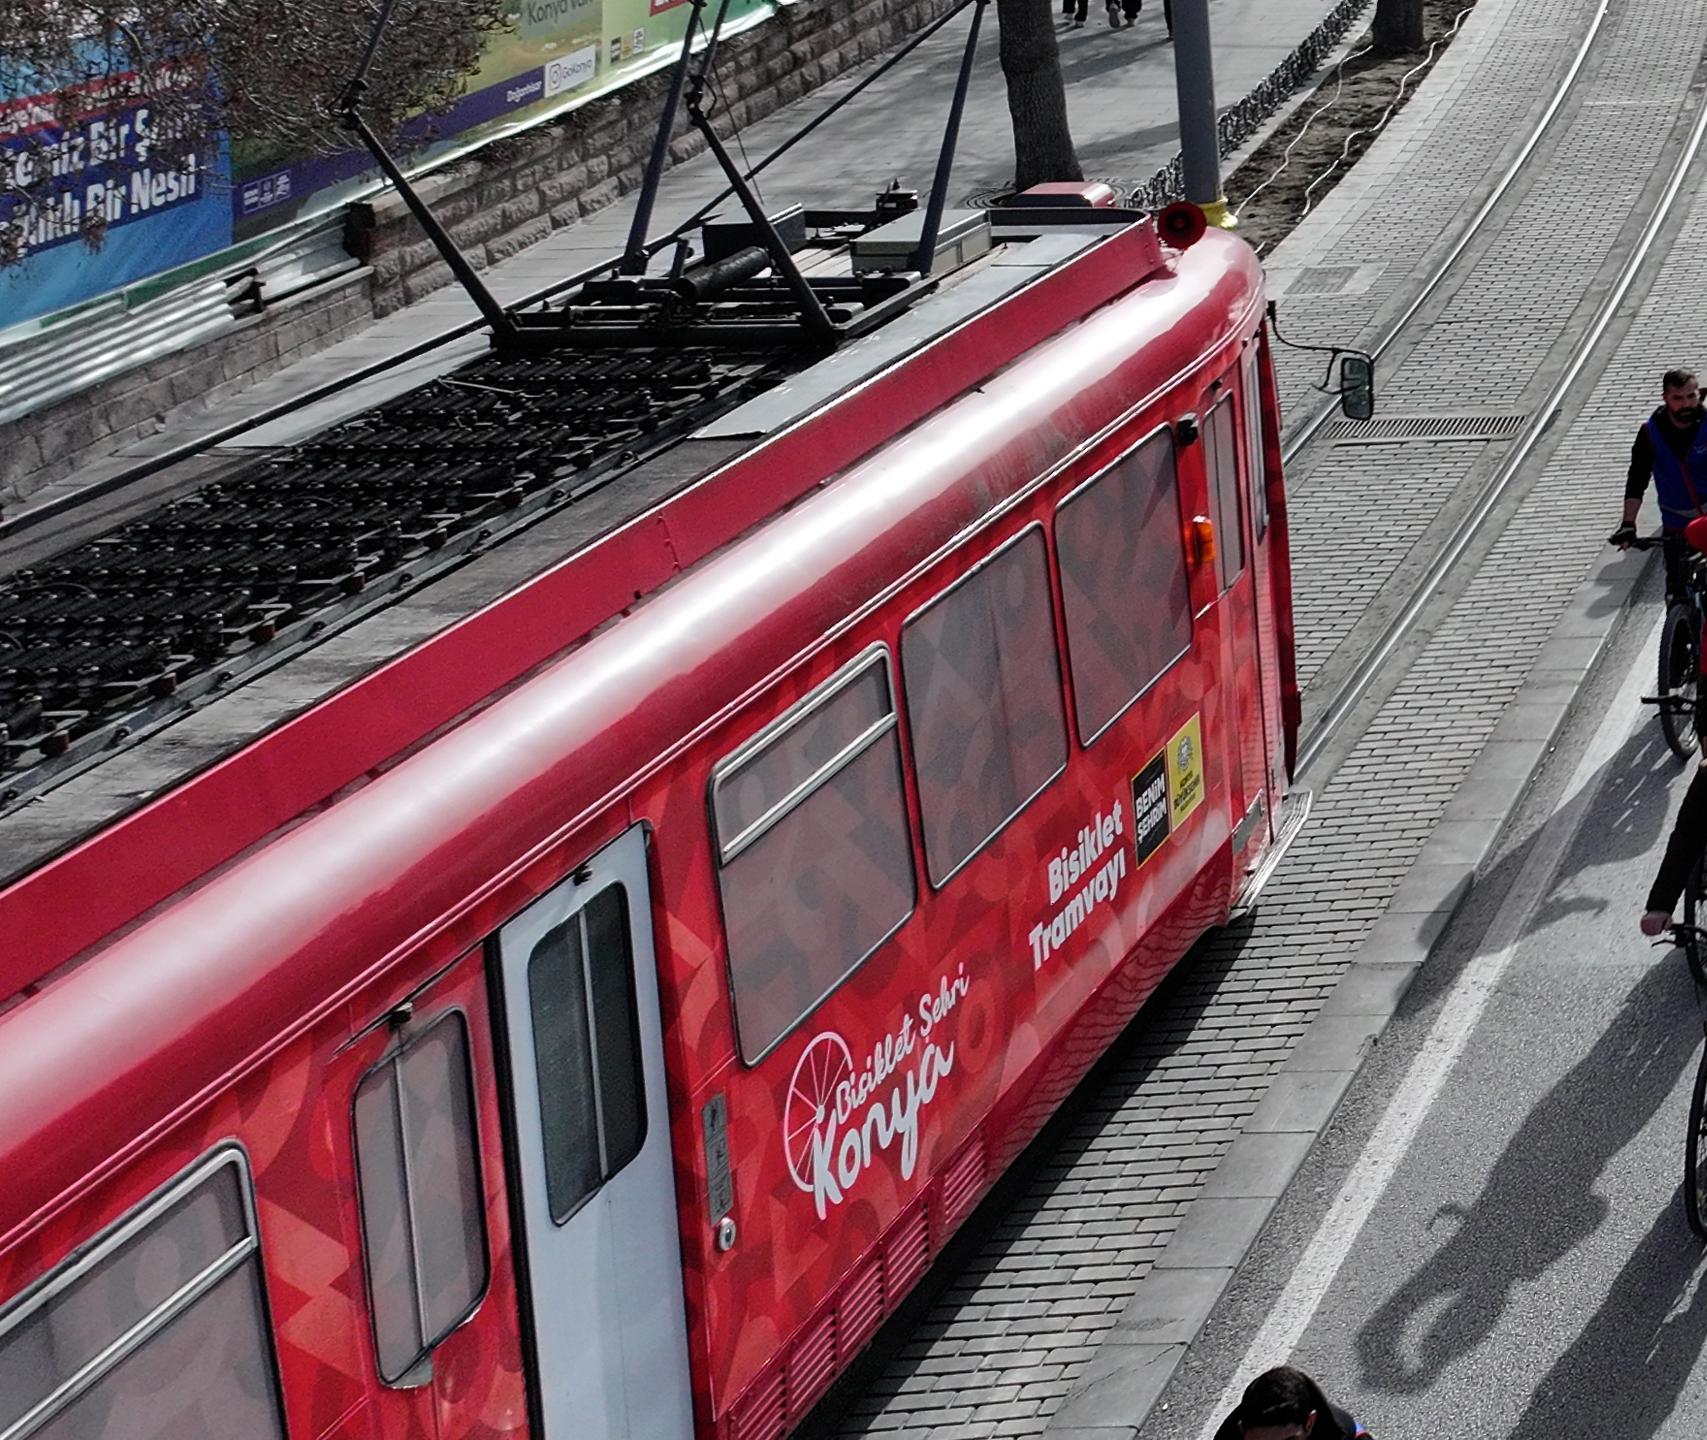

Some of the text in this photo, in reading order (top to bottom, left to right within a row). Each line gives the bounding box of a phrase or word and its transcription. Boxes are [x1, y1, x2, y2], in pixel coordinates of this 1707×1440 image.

[528, 0, 569, 26] Konya
[131, 153, 196, 214] Nesil
[1048, 799, 1123, 905] Bisiklet
[1137, 796, 1168, 844] ŞEHRİM
[1029, 848, 1126, 972] Tramvayı
[836, 1014, 917, 1126] Bisiklet
[813, 1040, 955, 1221] Konya
